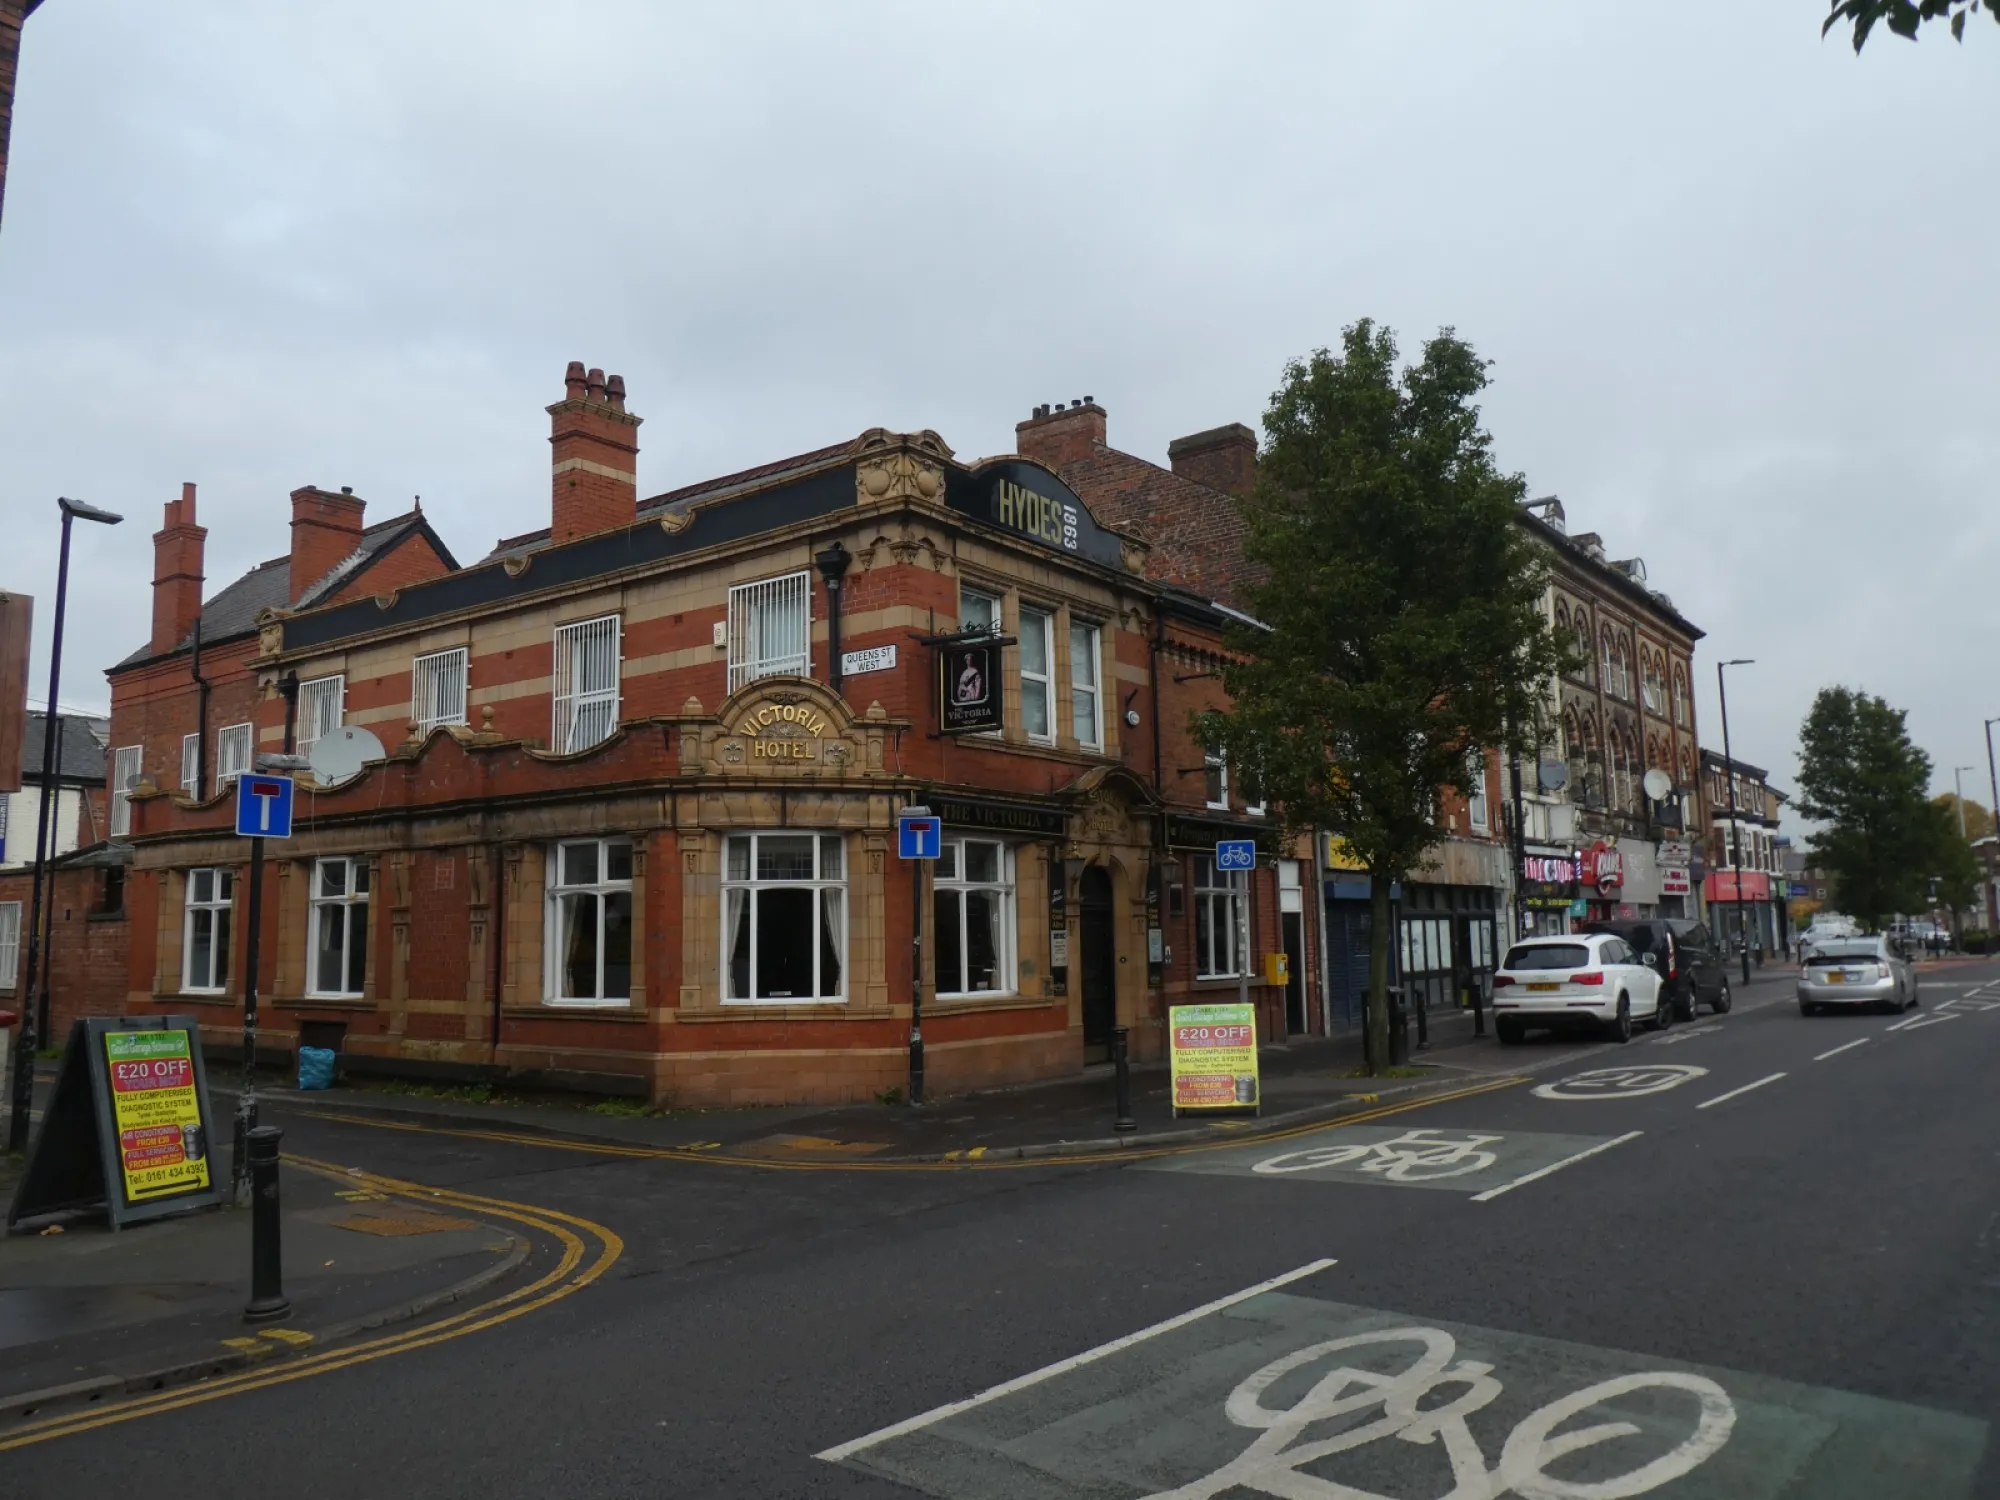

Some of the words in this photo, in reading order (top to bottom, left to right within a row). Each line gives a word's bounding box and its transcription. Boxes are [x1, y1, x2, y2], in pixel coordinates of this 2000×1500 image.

[999, 478, 1062, 545] HYDES
[1063, 504, 1078, 550] 1863
[846, 650, 879, 664] QUEENS
[881, 647, 892, 657] ST
[857, 660, 880, 671] WEST
[739, 704, 826, 738] VICTORIA
[948, 708, 992, 720] VICTORIA
[754, 740, 816, 759] HOTEL
[940, 803, 971, 821] THE
[974, 806, 1041, 828] VICTORIA
[1179, 1028, 1209, 1040] £20
[1214, 1027, 1249, 1039] OFF
[110, 1043, 129, 1054] Good
[130, 1042, 151, 1056] Garage
[1178, 1056, 1219, 1064] DIAGNOSTIC
[117, 1063, 149, 1079] £20
[154, 1060, 188, 1076] OFF
[124, 1077, 157, 1089] YOUR
[159, 1075, 183, 1086] MOT
[1565, 1070, 1683, 1087] 20
[117, 1092, 138, 1102] FULLY
[139, 1088, 192, 1100] COMPUTERISED
[120, 1102, 163, 1113] DIAGNOSTIC
[165, 1099, 191, 1108] SYSTEM
[122, 1132, 134, 1140] AIR
[134, 1126, 179, 1139] CONDITIONING
[136, 1137, 157, 1147] FROM
[128, 1150, 144, 1159] FULL
[146, 1145, 179, 1156] SERVICING
[128, 1159, 150, 1169] FROM
[128, 1173, 144, 1185] Tel:
[146, 1170, 166, 1182] 0161
[169, 1167, 184, 1177] 434
[186, 1163, 205, 1174] 4392
